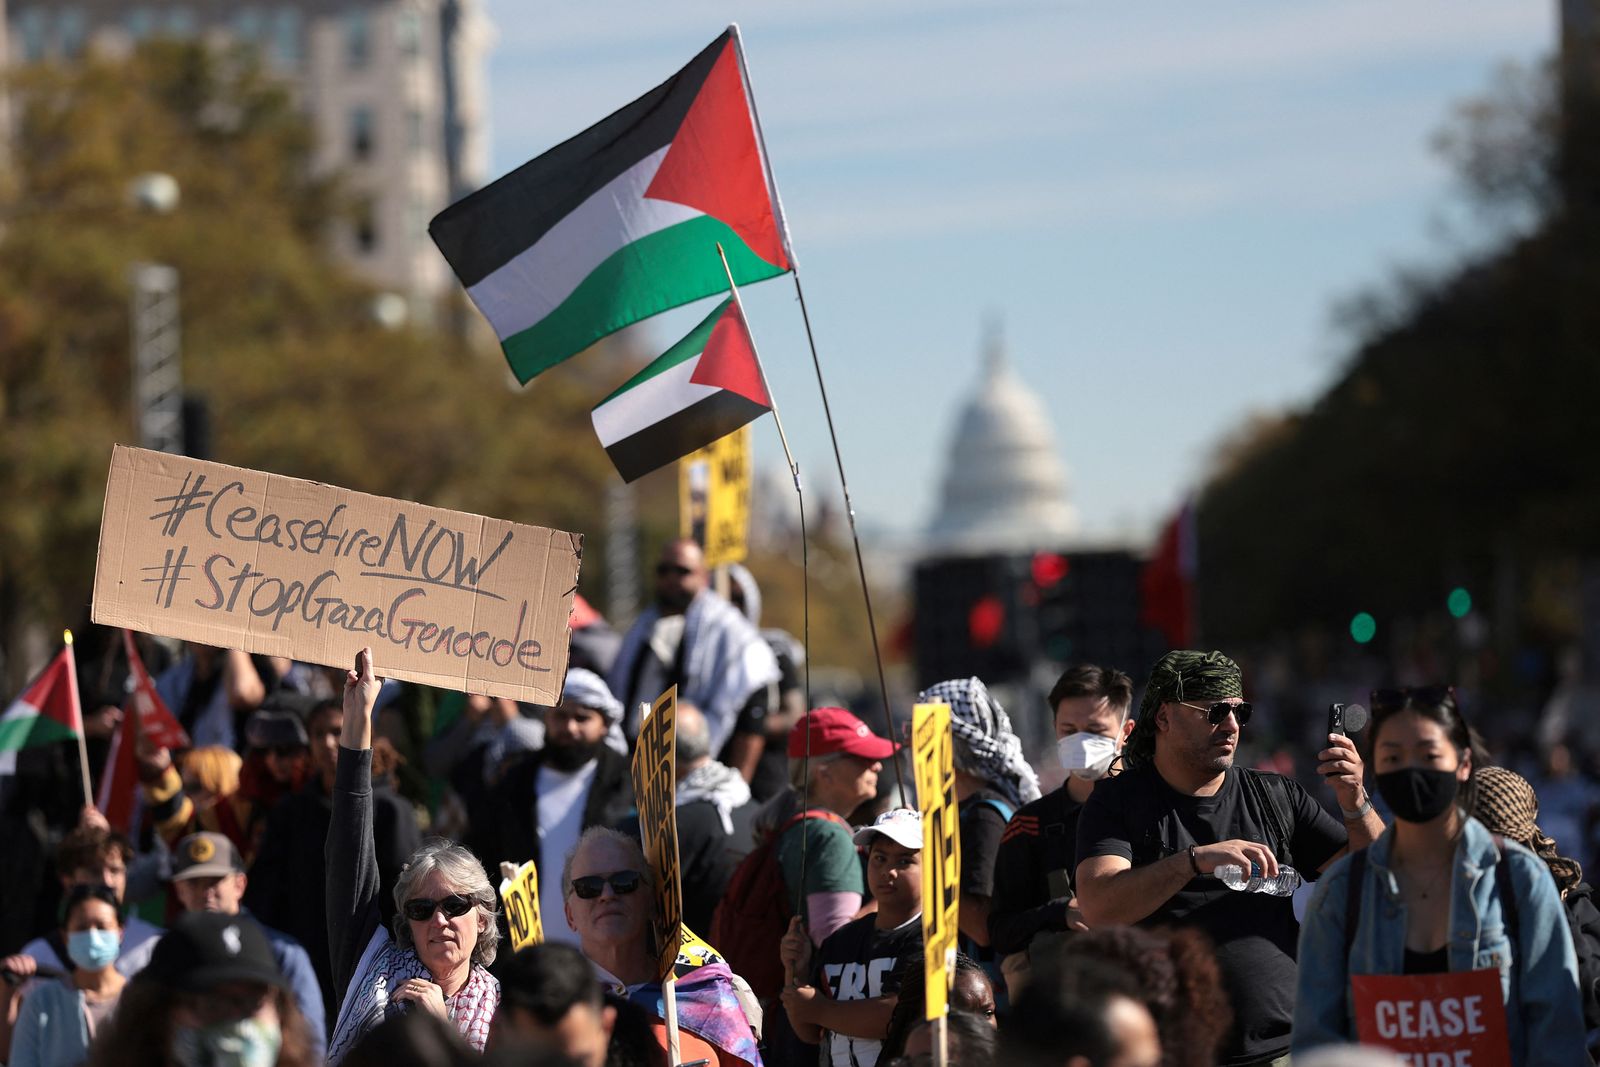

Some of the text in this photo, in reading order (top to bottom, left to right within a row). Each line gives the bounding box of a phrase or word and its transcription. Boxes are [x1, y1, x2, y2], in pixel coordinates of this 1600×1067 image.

[150, 471, 513, 586] #CeasefireNOW
[140, 545, 552, 673] #StopGazaGenocide
[643, 696, 672, 782] THE
[644, 760, 673, 848] WAR
[660, 821, 677, 879] ON
[823, 957, 898, 1001] FRE
[1375, 995, 1486, 1039] CEASE
